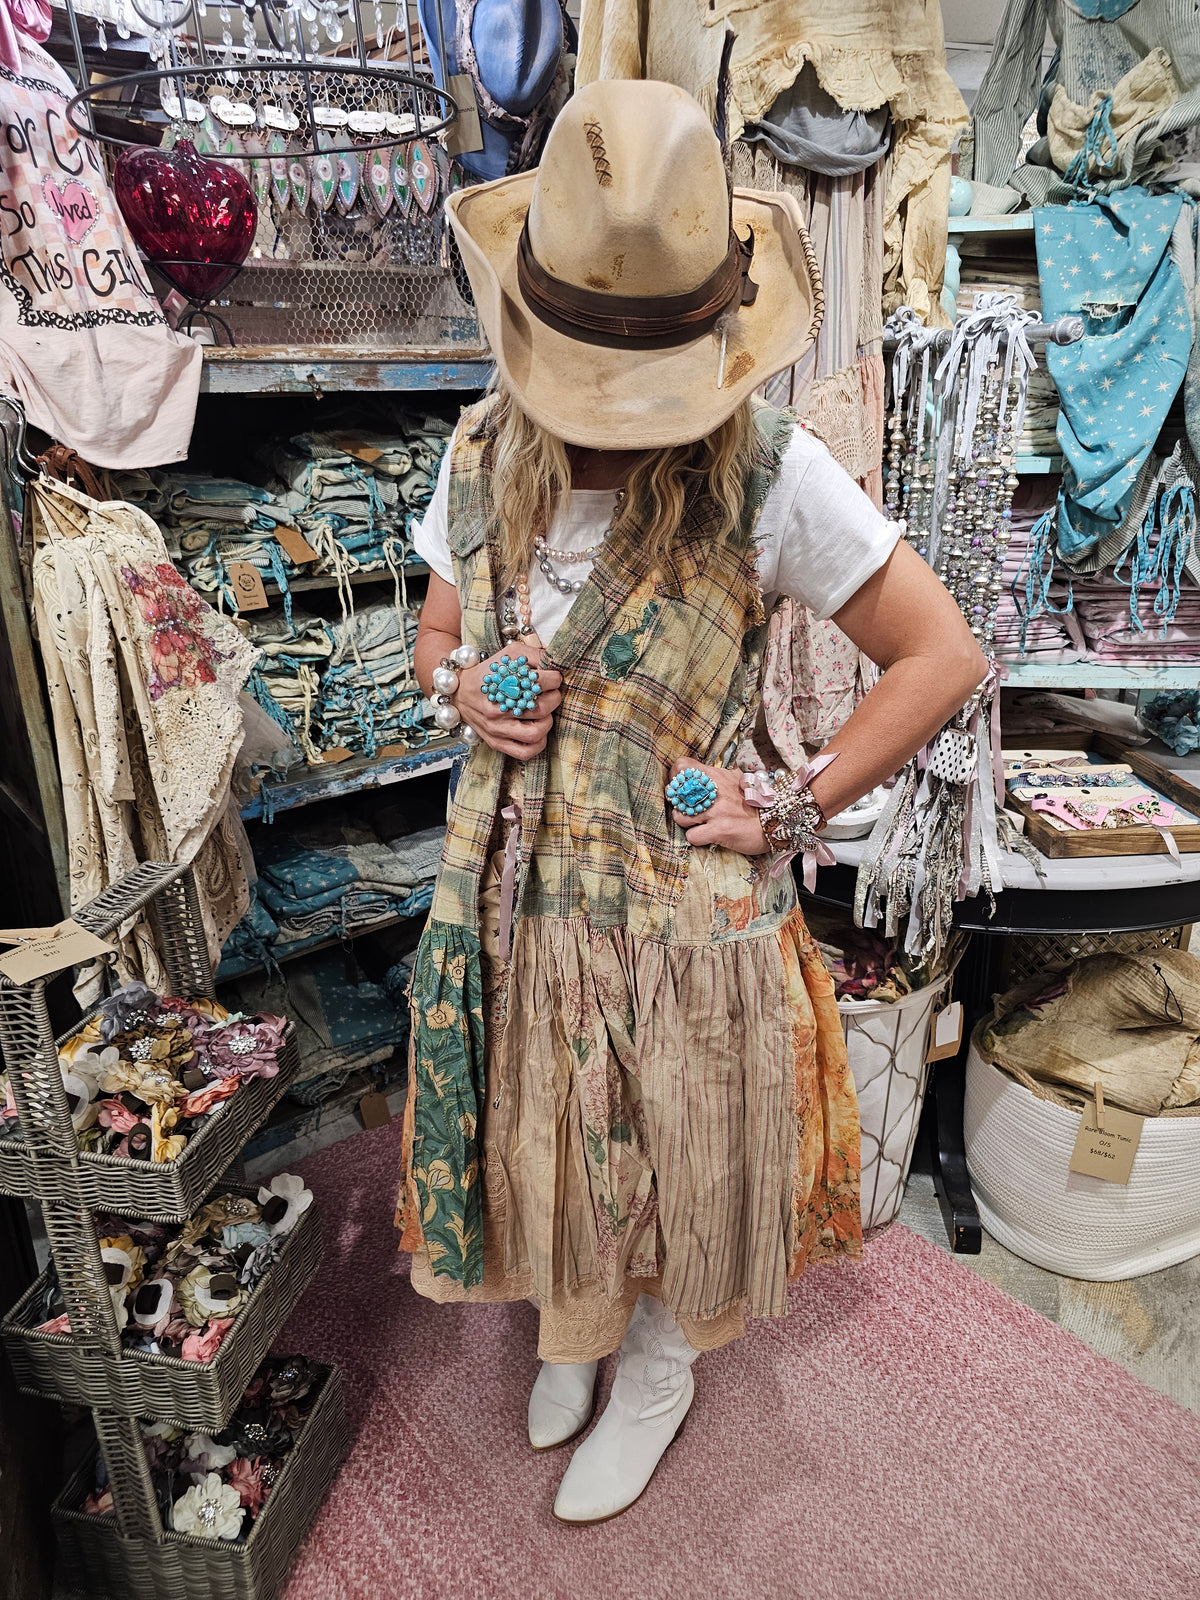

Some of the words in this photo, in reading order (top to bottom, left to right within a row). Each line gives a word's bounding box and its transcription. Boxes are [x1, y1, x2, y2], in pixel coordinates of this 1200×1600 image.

[0, 110, 38, 173] or
[0, 194, 36, 237] So
[10, 246, 74, 296] This
